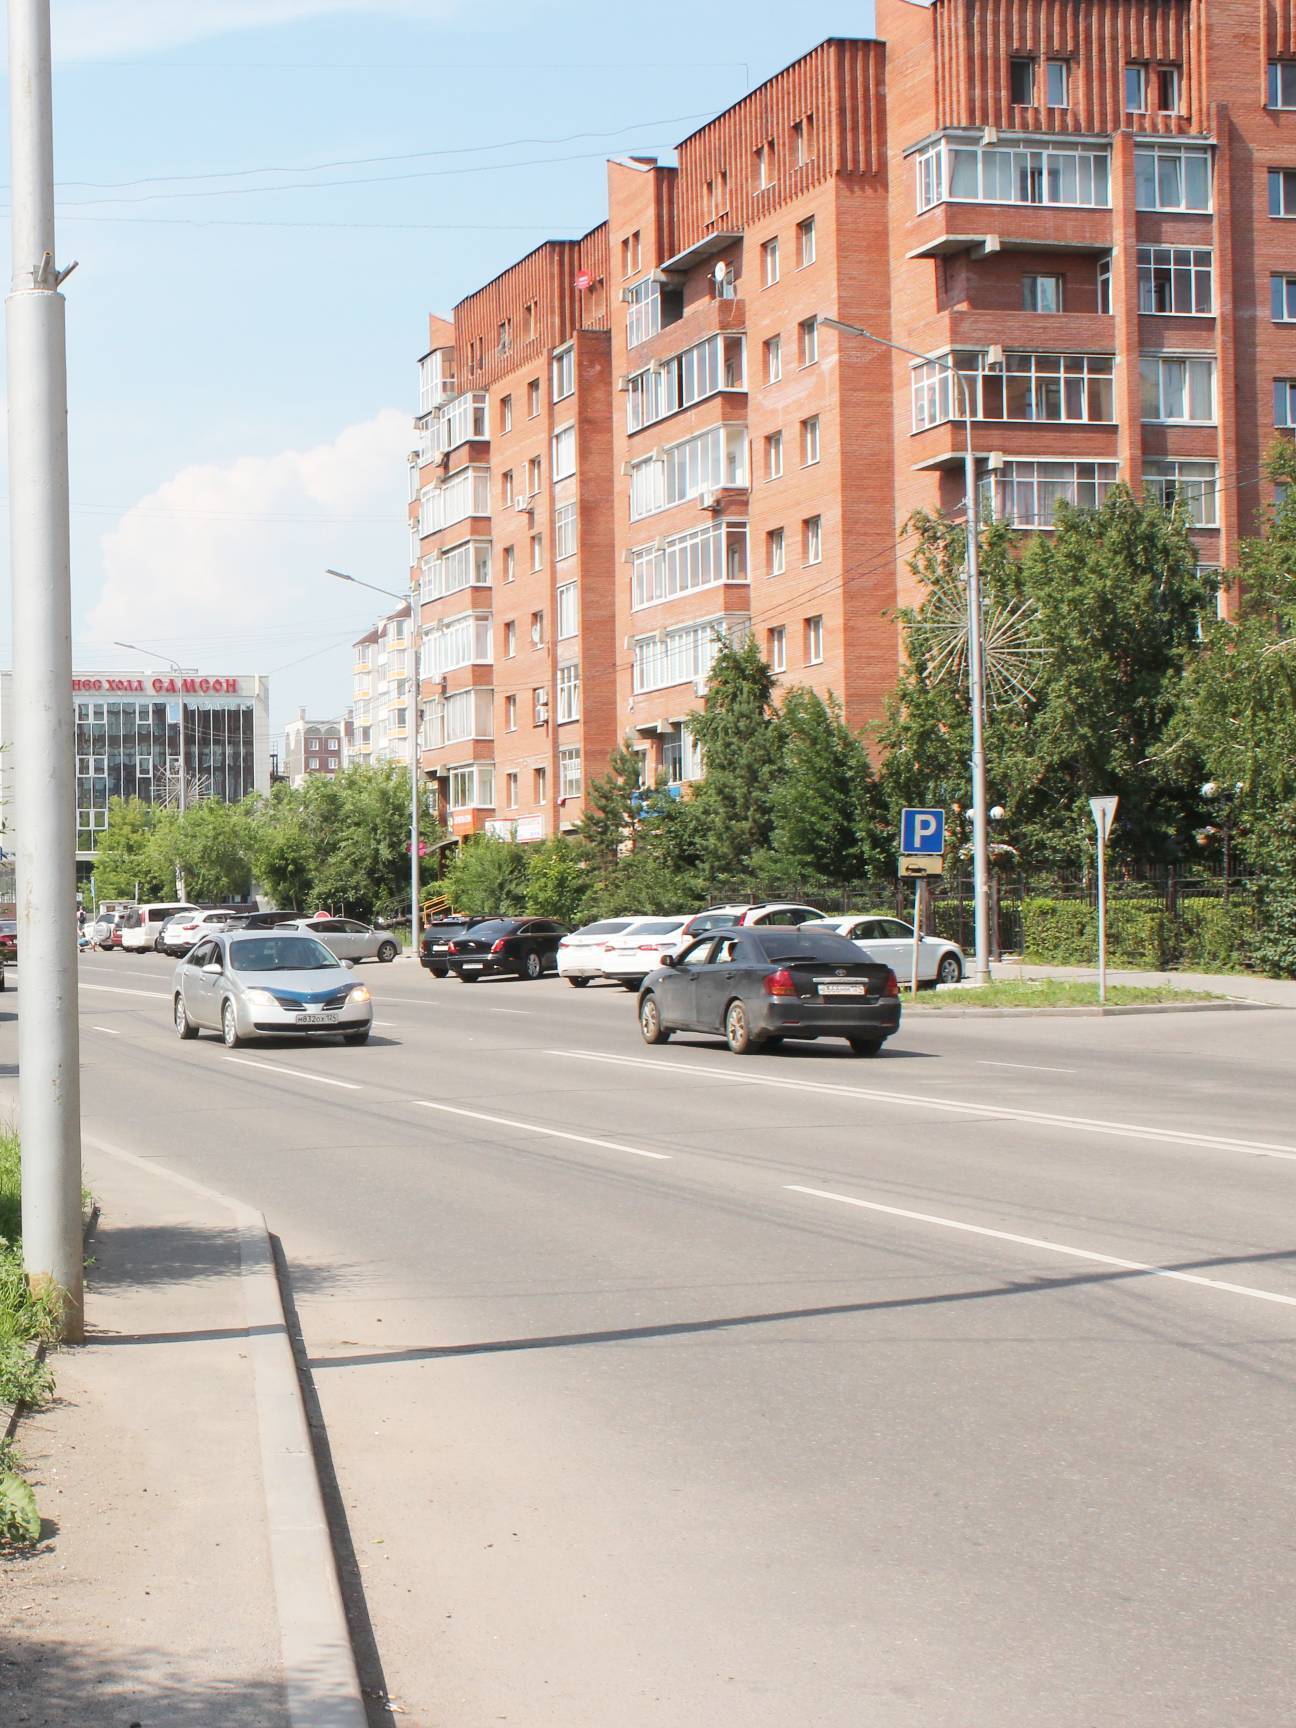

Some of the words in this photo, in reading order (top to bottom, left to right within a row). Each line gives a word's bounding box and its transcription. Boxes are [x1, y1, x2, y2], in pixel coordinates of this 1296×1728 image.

[72, 679, 102, 691] НЕС
[152, 678, 238, 693] САМСОН
[914, 814, 937, 848] P
